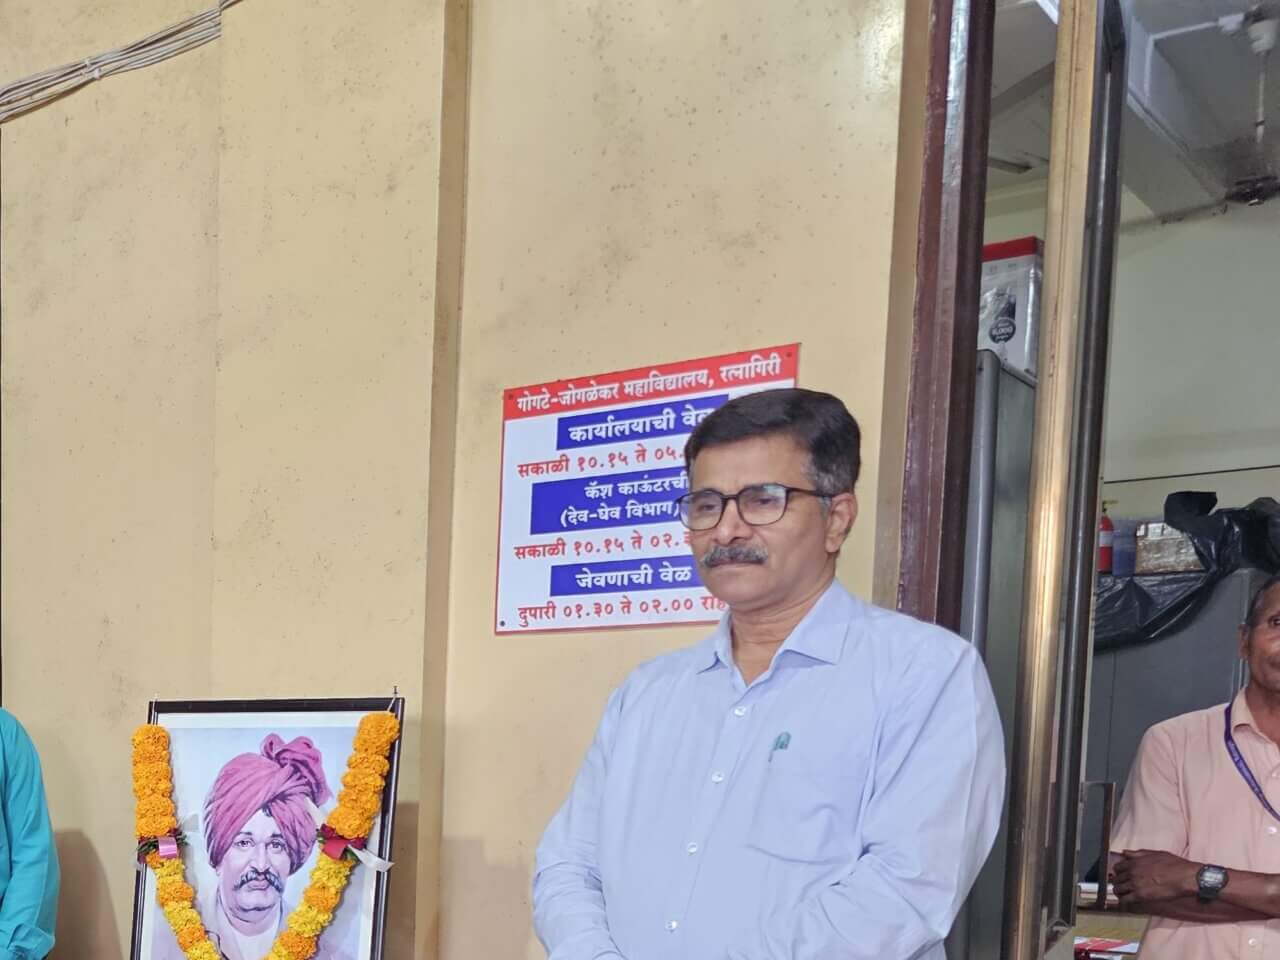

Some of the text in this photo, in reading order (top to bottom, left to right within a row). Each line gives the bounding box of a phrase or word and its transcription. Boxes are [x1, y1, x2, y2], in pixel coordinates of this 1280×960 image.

[517, 352, 782, 412] गोगटे-जोगळेकर महाविद्यालय, रत्नागिरी
[568, 407, 677, 442] कार्यालयाची
[517, 454, 570, 478] सकाळी
[577, 452, 629, 472] १०.१५
[634, 443, 647, 463] ते
[585, 480, 613, 499] कॅश
[560, 499, 679, 527] (देव-घेव विभाग)
[514, 537, 566, 559] सकाळी
[573, 537, 625, 556] १०.१५
[631, 530, 643, 549] ते
[575, 561, 693, 588] जेवणाची वेळ
[518, 601, 556, 627] दुपारी
[563, 602, 614, 619] ०१.३०
[620, 596, 632, 615] ते
[639, 598, 694, 613] ०२.००
